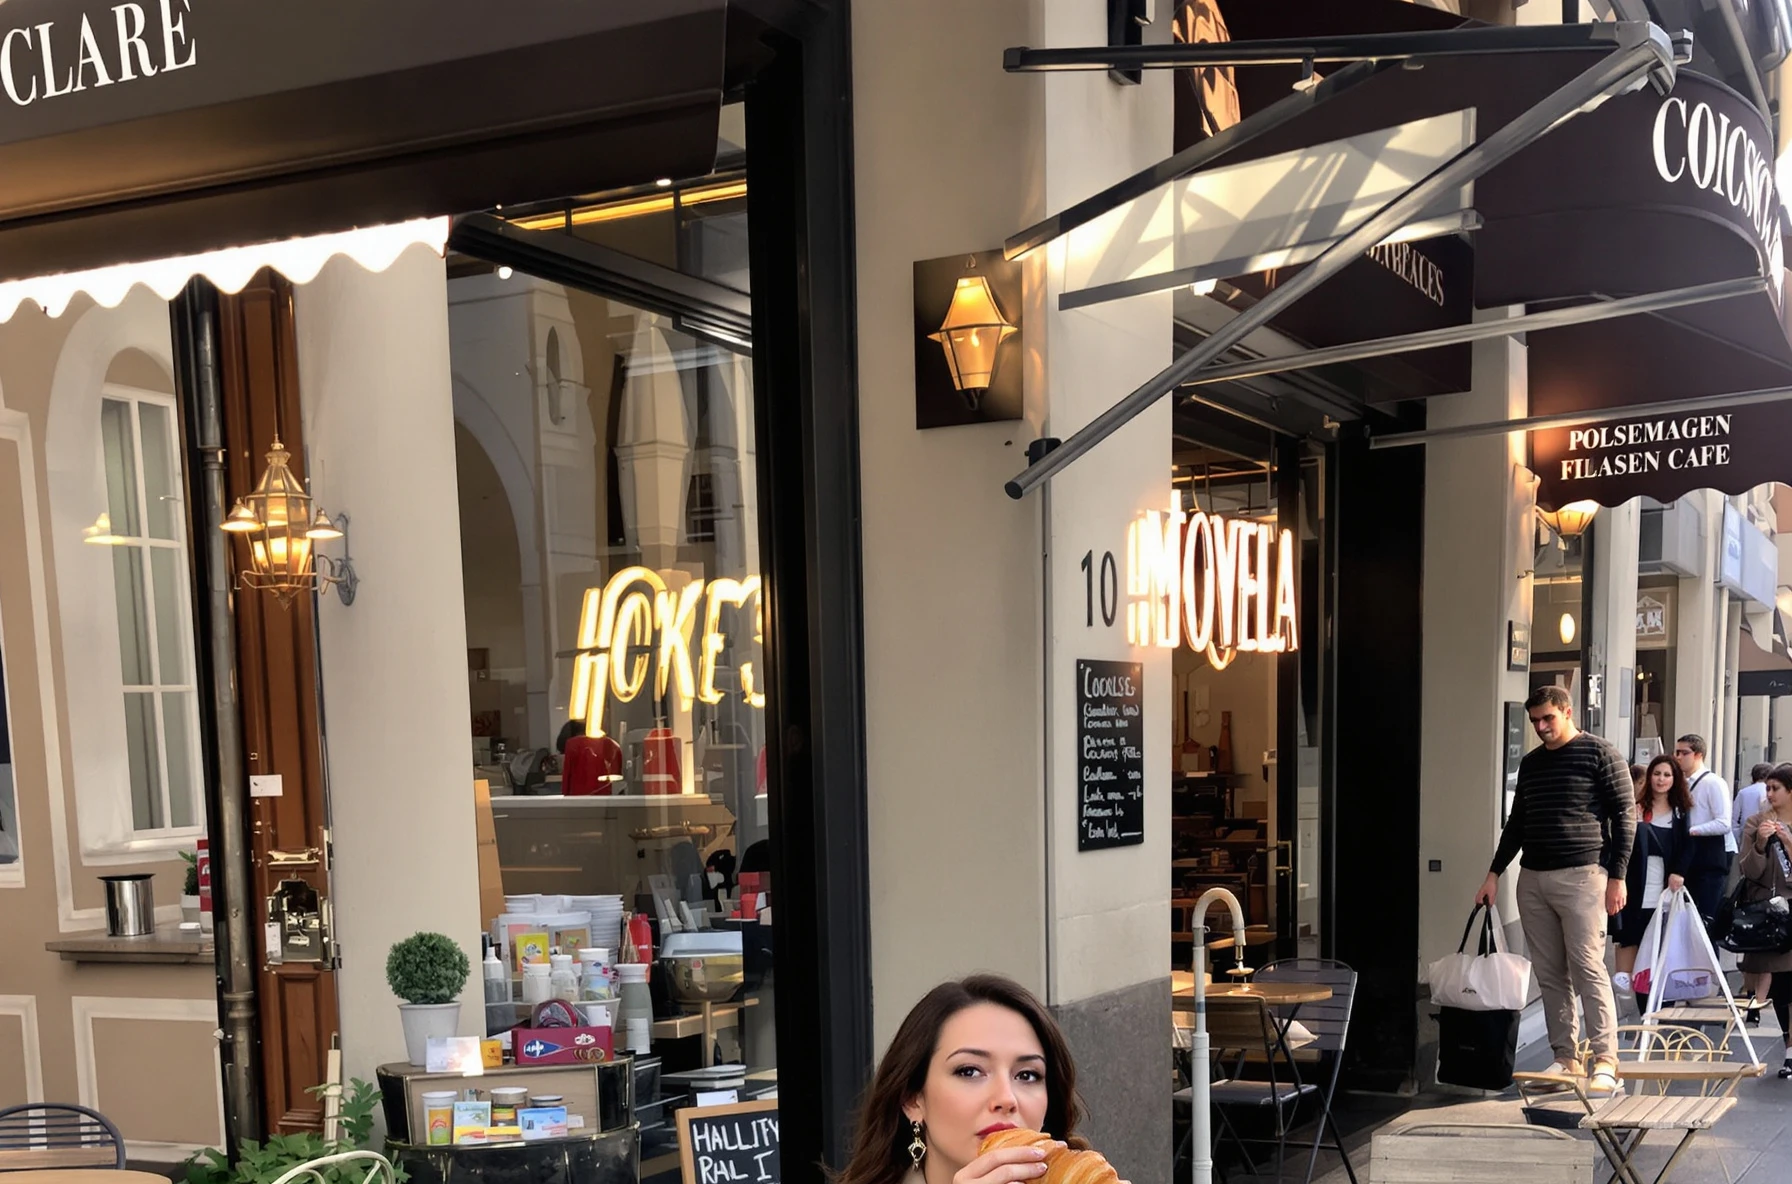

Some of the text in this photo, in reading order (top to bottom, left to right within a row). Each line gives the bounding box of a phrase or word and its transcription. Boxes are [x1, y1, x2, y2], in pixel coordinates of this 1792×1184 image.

[0, 0, 196, 106] CLARE
[1568, 414, 1733, 451] POLSEMAGEN
[1560, 444, 1730, 481] FILASEN CAFE
[1081, 549, 1118, 627] 10
